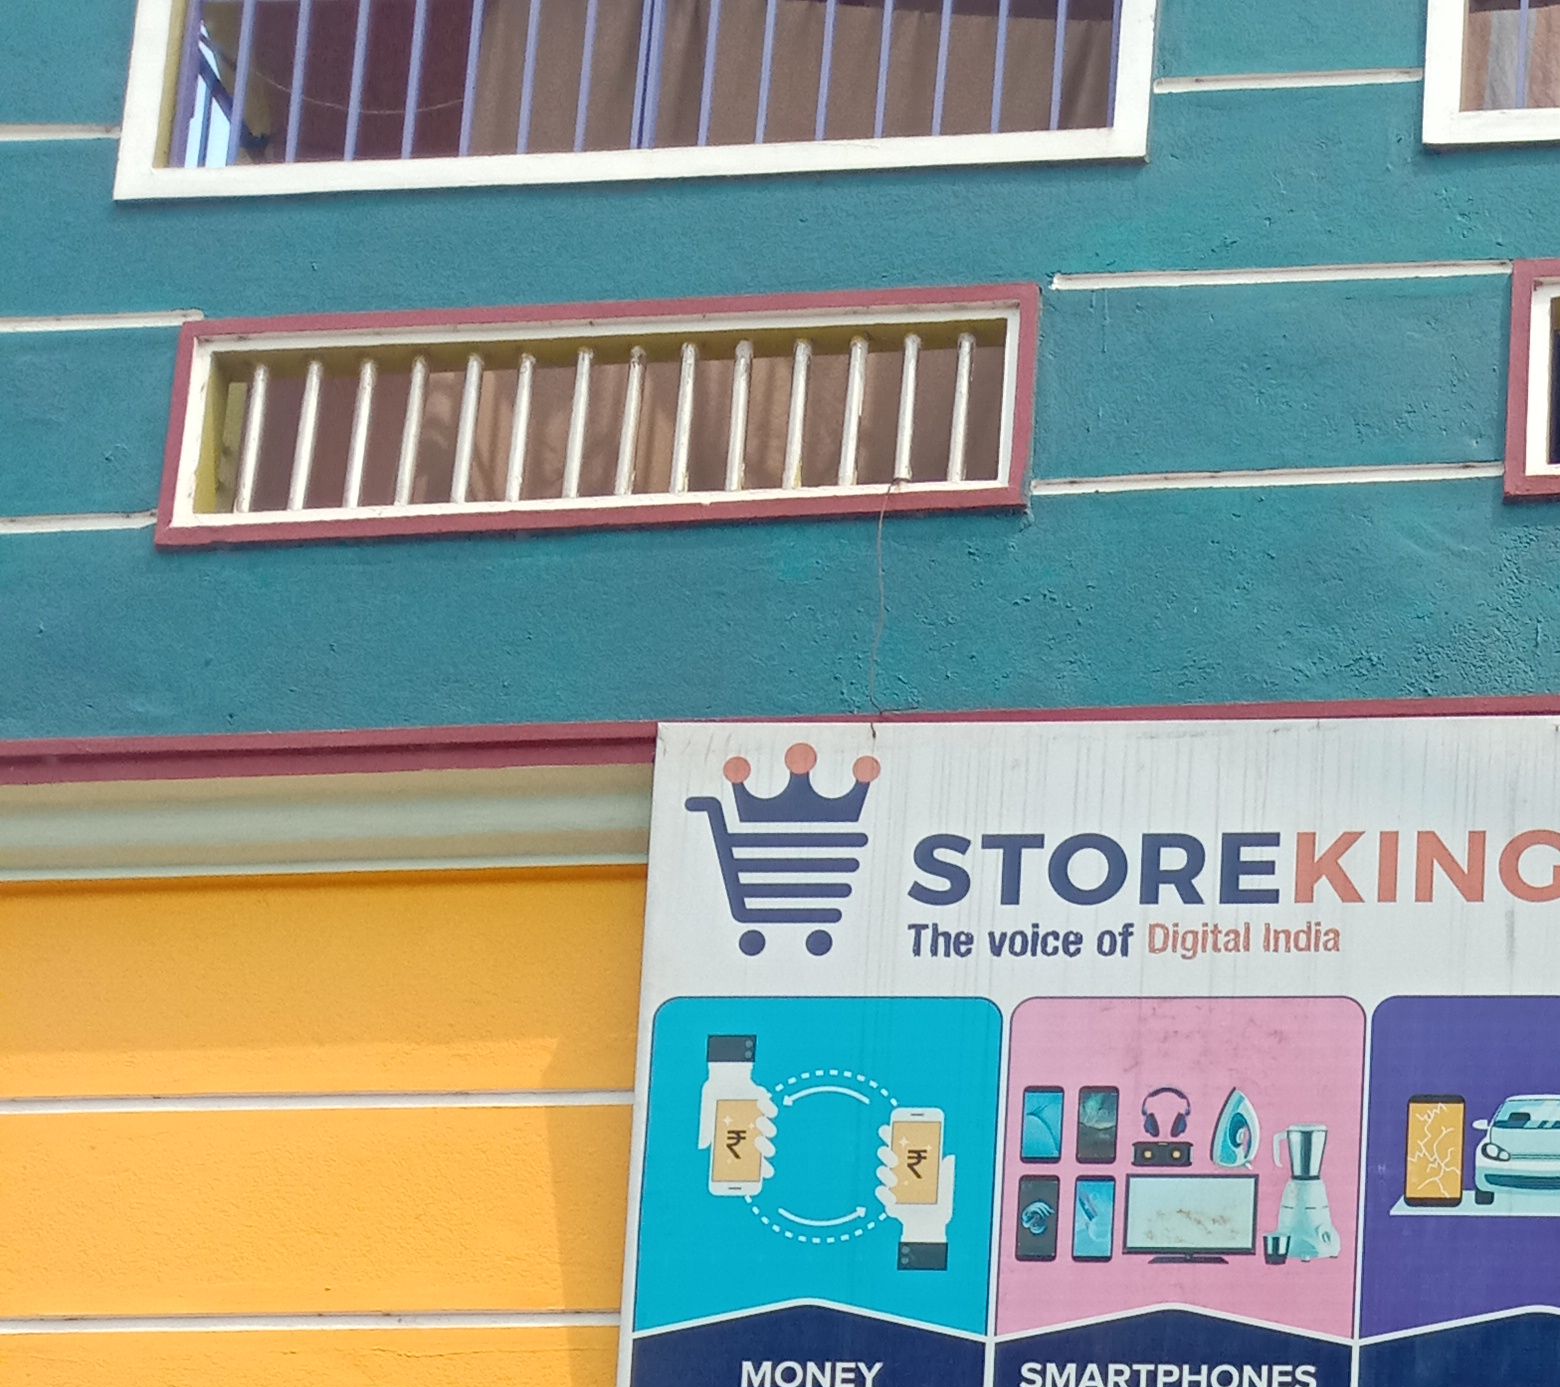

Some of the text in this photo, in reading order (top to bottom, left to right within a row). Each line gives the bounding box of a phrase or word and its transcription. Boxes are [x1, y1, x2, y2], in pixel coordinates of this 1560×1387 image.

[907, 920, 1341, 960] The voice of Digital India
